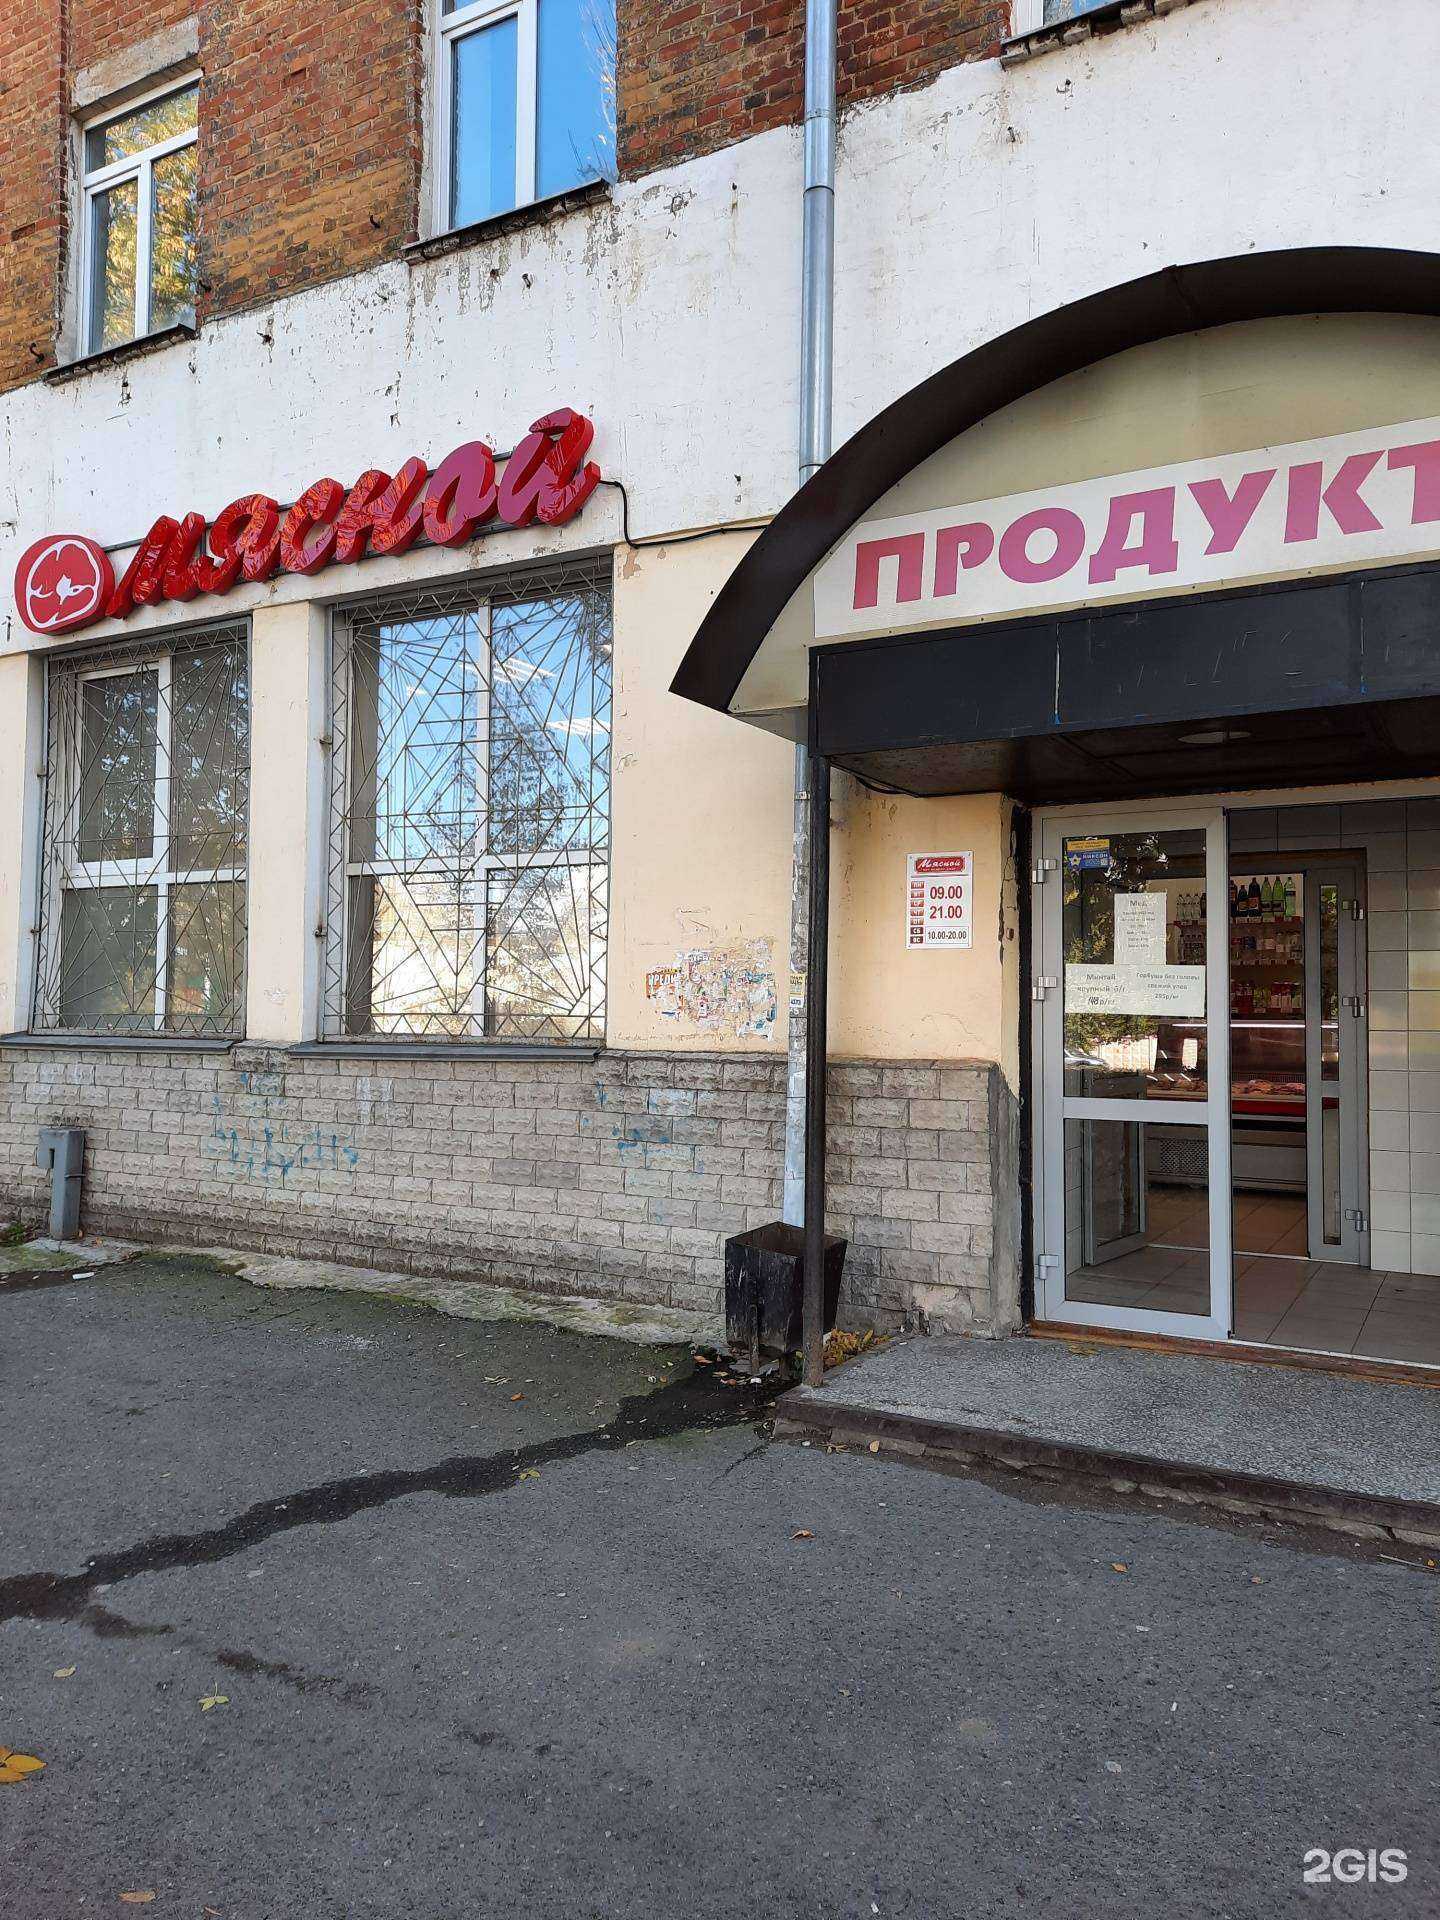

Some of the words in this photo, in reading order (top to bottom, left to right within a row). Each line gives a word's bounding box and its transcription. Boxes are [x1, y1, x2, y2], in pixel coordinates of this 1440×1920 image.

[852, 440, 1440, 610] ПРОДУКТ
[929, 885, 963, 900] 09.00
[929, 905, 963, 919] 21.00
[928, 930, 967, 940] 10.00-20.00
